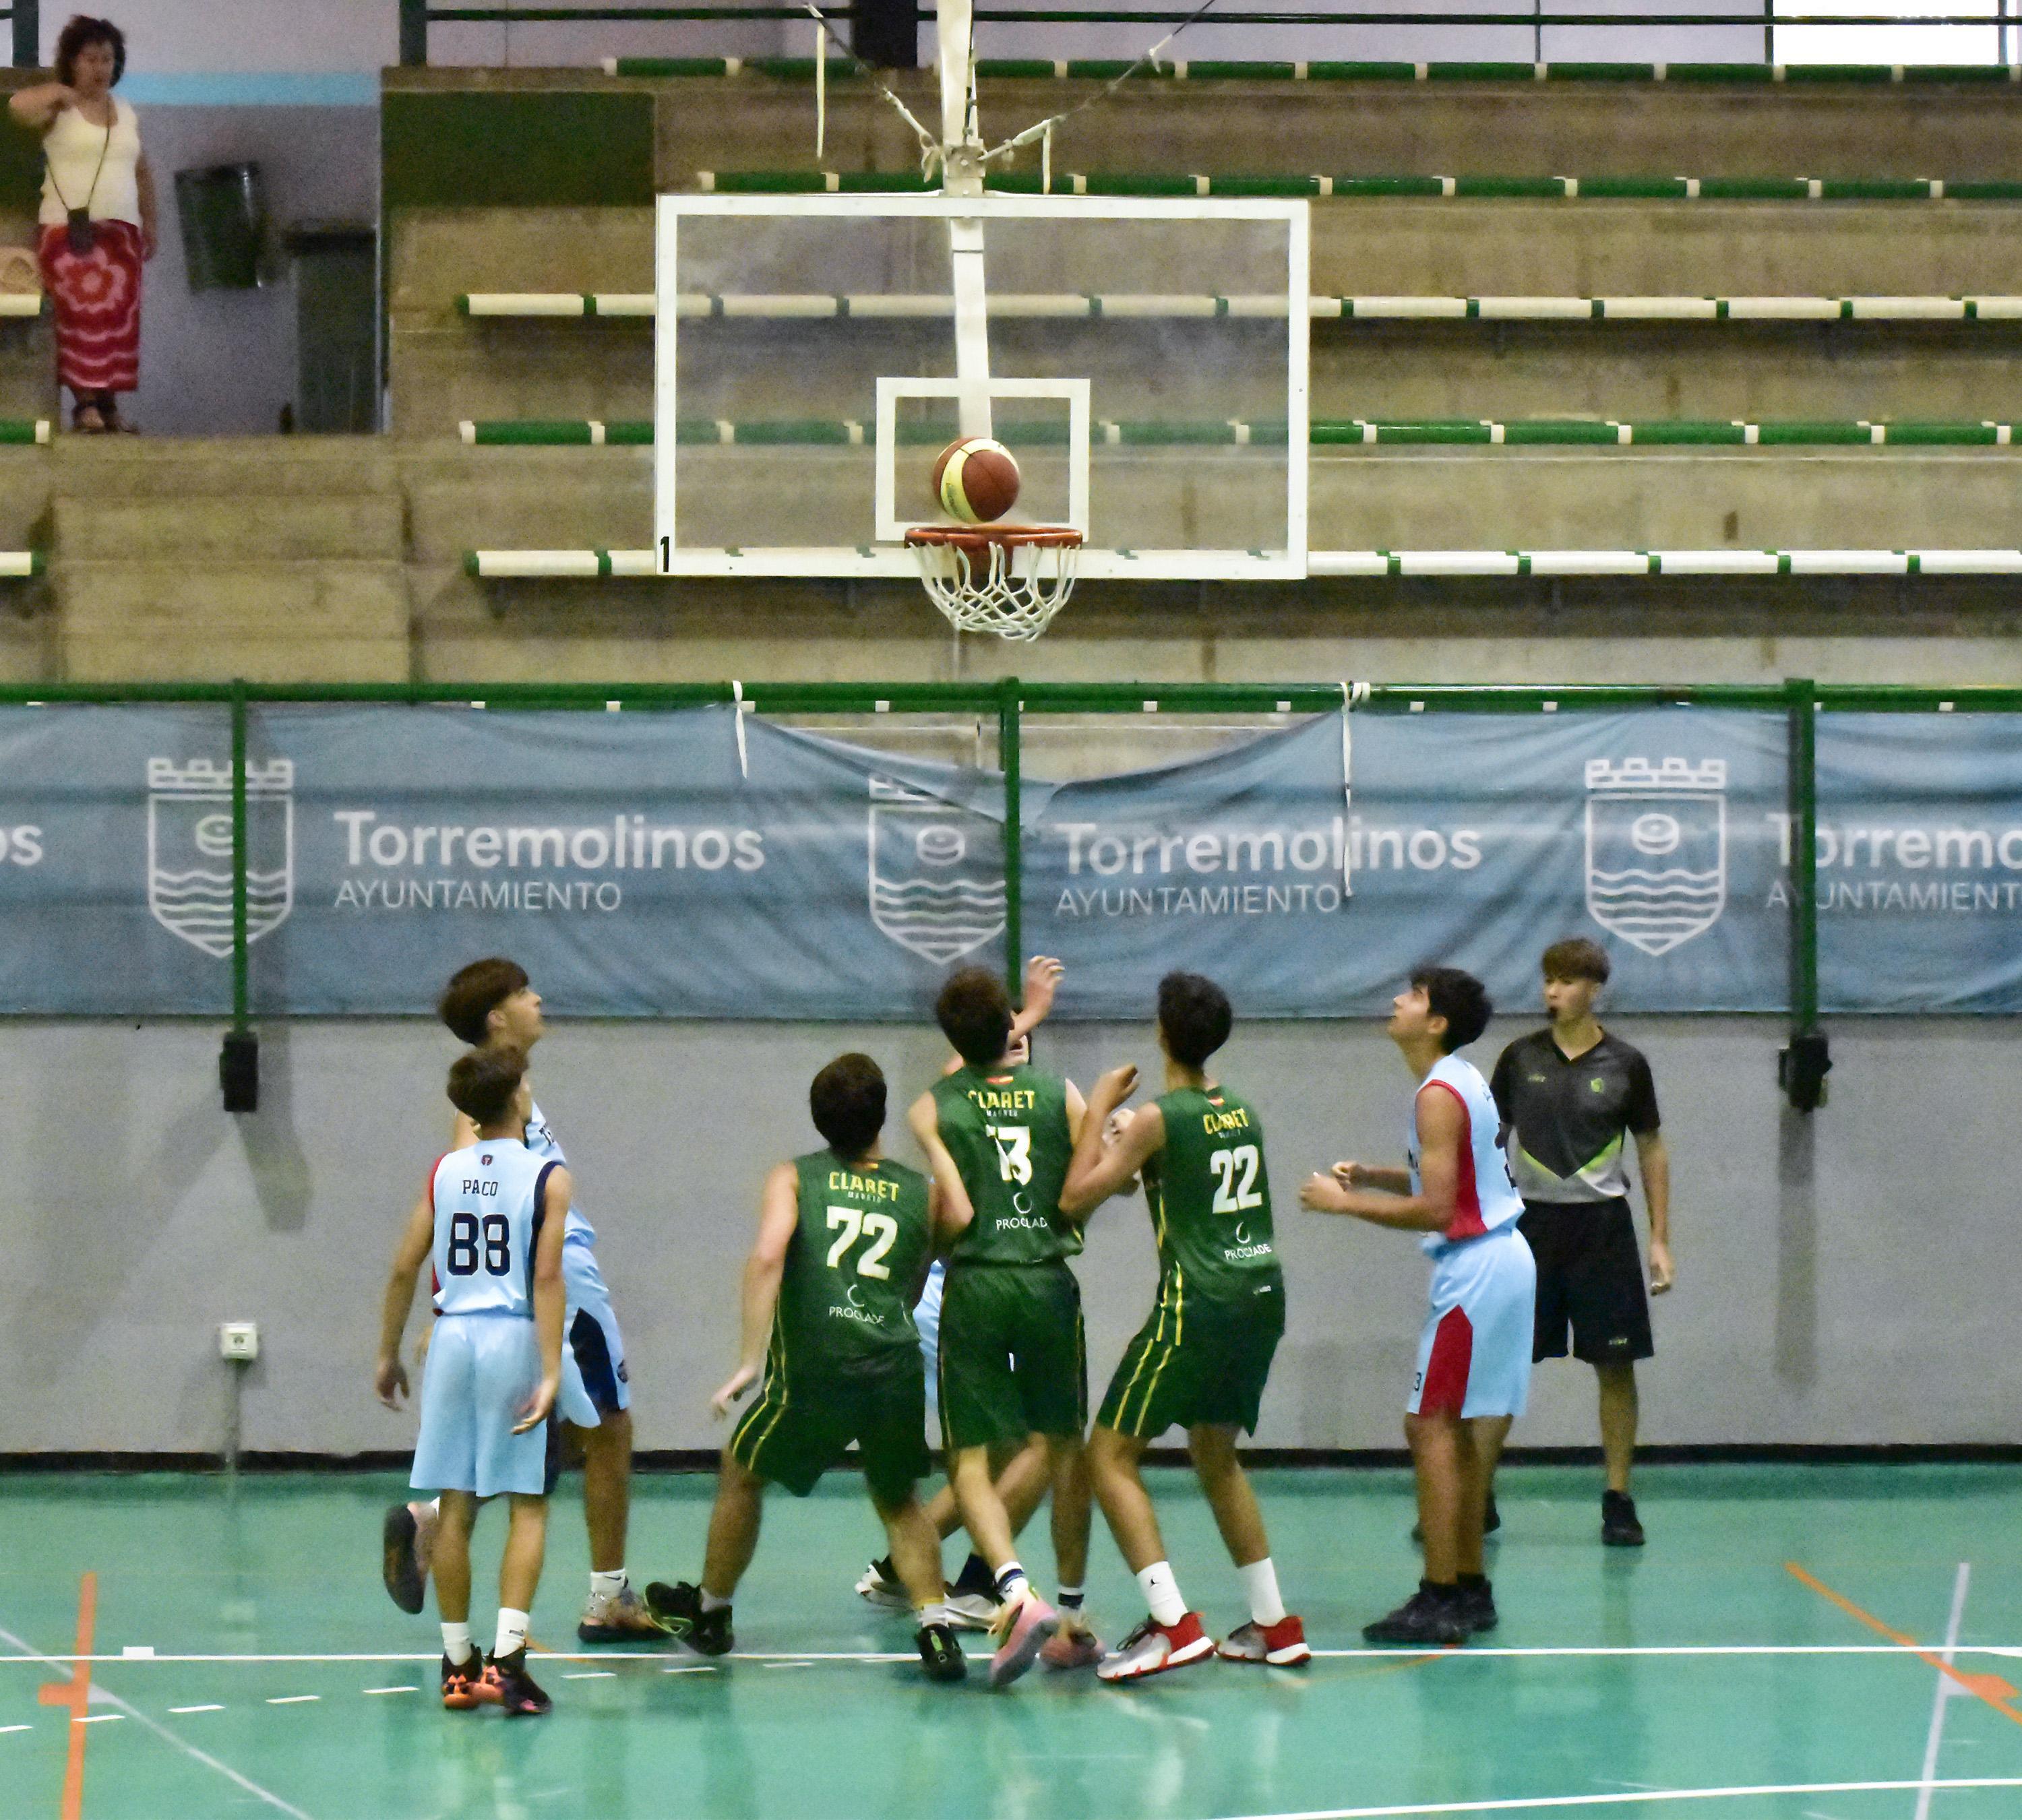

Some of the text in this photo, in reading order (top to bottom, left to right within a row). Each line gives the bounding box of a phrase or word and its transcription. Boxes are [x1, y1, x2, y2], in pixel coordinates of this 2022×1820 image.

[660, 536, 669, 573] 1
[334, 811, 765, 871] Torremolinos
[1054, 816, 1482, 875] Torremolinos
[334, 879, 621, 911] AYUNTAMIENTO
[1055, 883, 1340, 917] AYUNTAMIENTO
[462, 1179, 499, 1197] PACO
[829, 1170, 900, 1202] CLARET
[1210, 1144, 1262, 1214] 22
[447, 1212, 510, 1277] 88
[826, 1205, 898, 1281] 72
